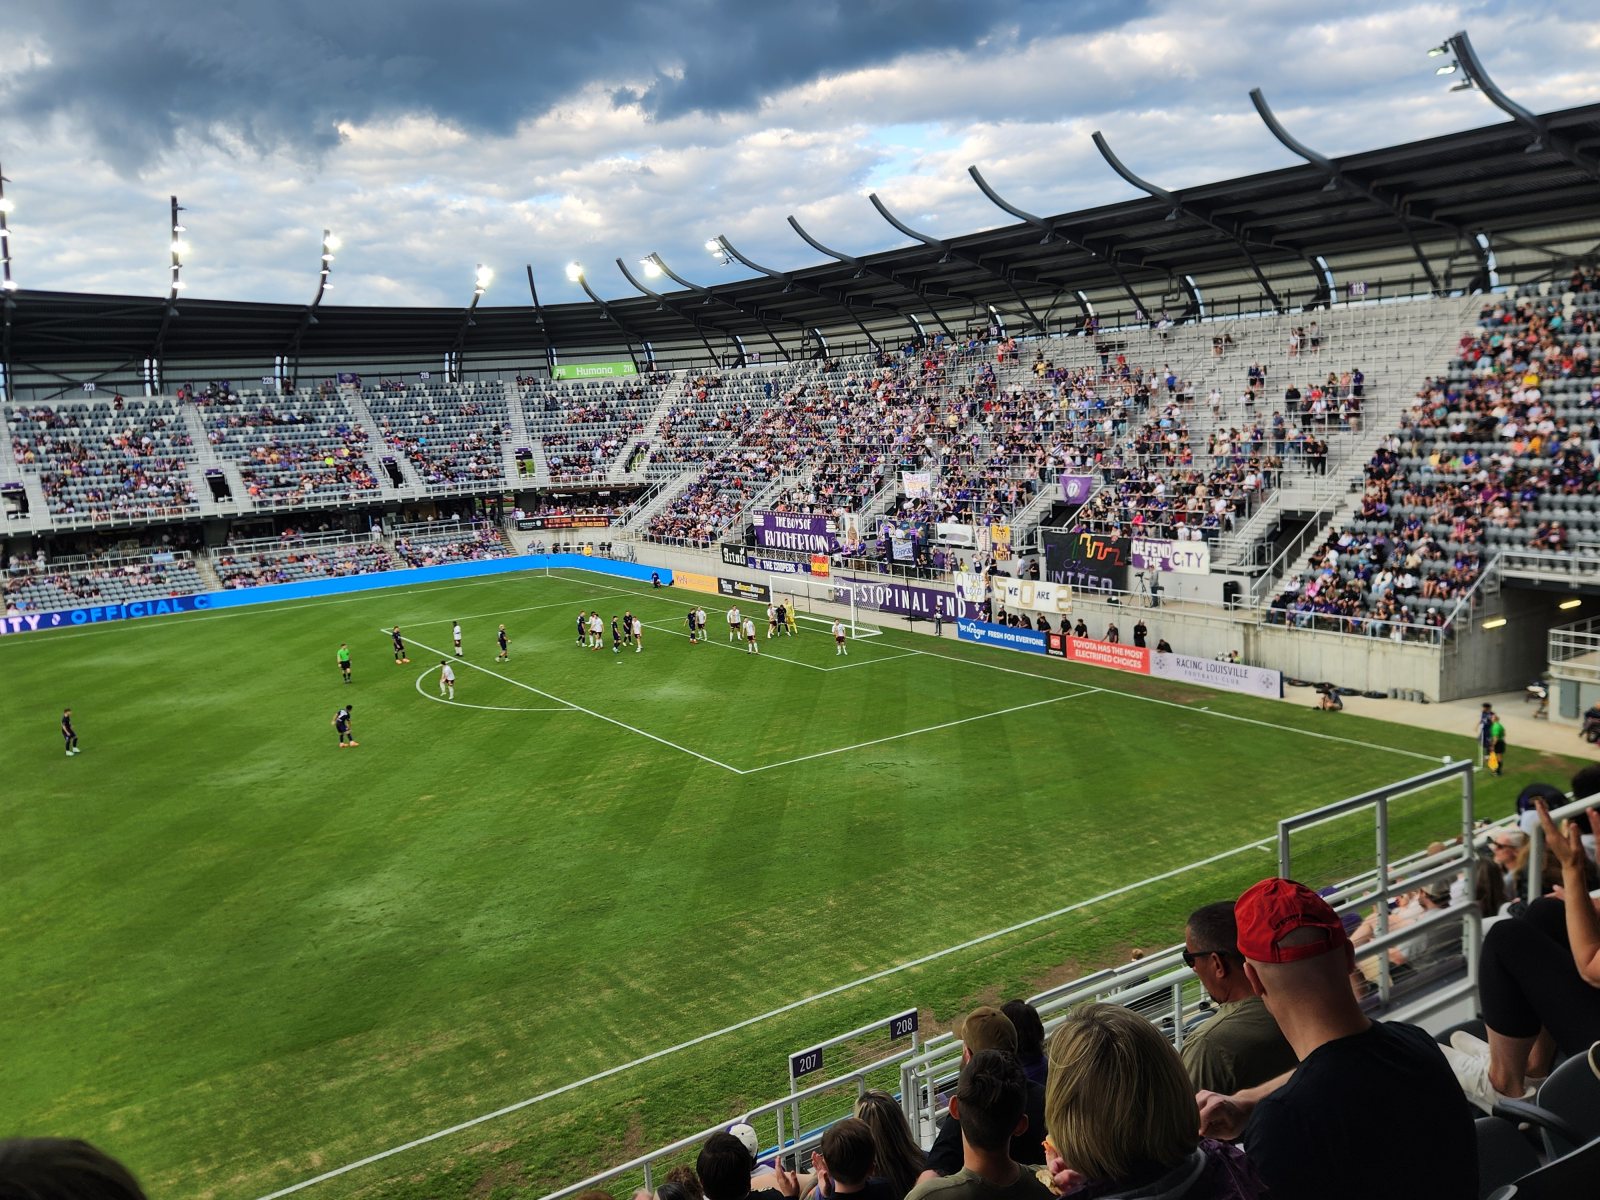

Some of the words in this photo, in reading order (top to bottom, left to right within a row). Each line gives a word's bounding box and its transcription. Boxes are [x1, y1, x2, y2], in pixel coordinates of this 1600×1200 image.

[576, 366, 613, 376] Humana
[83, 382, 95, 391] 221
[775, 516, 787, 529] THE
[787, 517, 804, 530] BOYS
[804, 518, 812, 530] OF
[764, 530, 829, 552] BUTCHERTOWN
[1132, 539, 1171, 558] DEFEND
[762, 560, 774, 570] THE
[773, 561, 796, 573] COOPERS
[1142, 555, 1162, 570] THE
[1008, 586, 1018, 596] WE
[1036, 590, 1050, 600] ARE
[70, 599, 184, 625] OFFICIAL
[966, 622, 986, 640] Kroger
[987, 630, 1003, 640] FRESH
[1003, 633, 1015, 642] FOR
[1015, 635, 1046, 647] EVERYONE.
[1048, 649, 1063, 657] TOYOTA
[1072, 639, 1097, 651] TOYOTA
[1097, 644, 1111, 654] HAS
[1111, 646, 1124, 655] THE
[1124, 648, 1144, 659] MOST
[1075, 649, 1113, 664] ELECTRIFIED
[1112, 656, 1142, 668] CHOICES
[1176, 657, 1202, 671] RACING
[1206, 662, 1248, 679] LOUISVILLE
[896, 1017, 913, 1035] 208
[799, 1053, 817, 1073] 207
